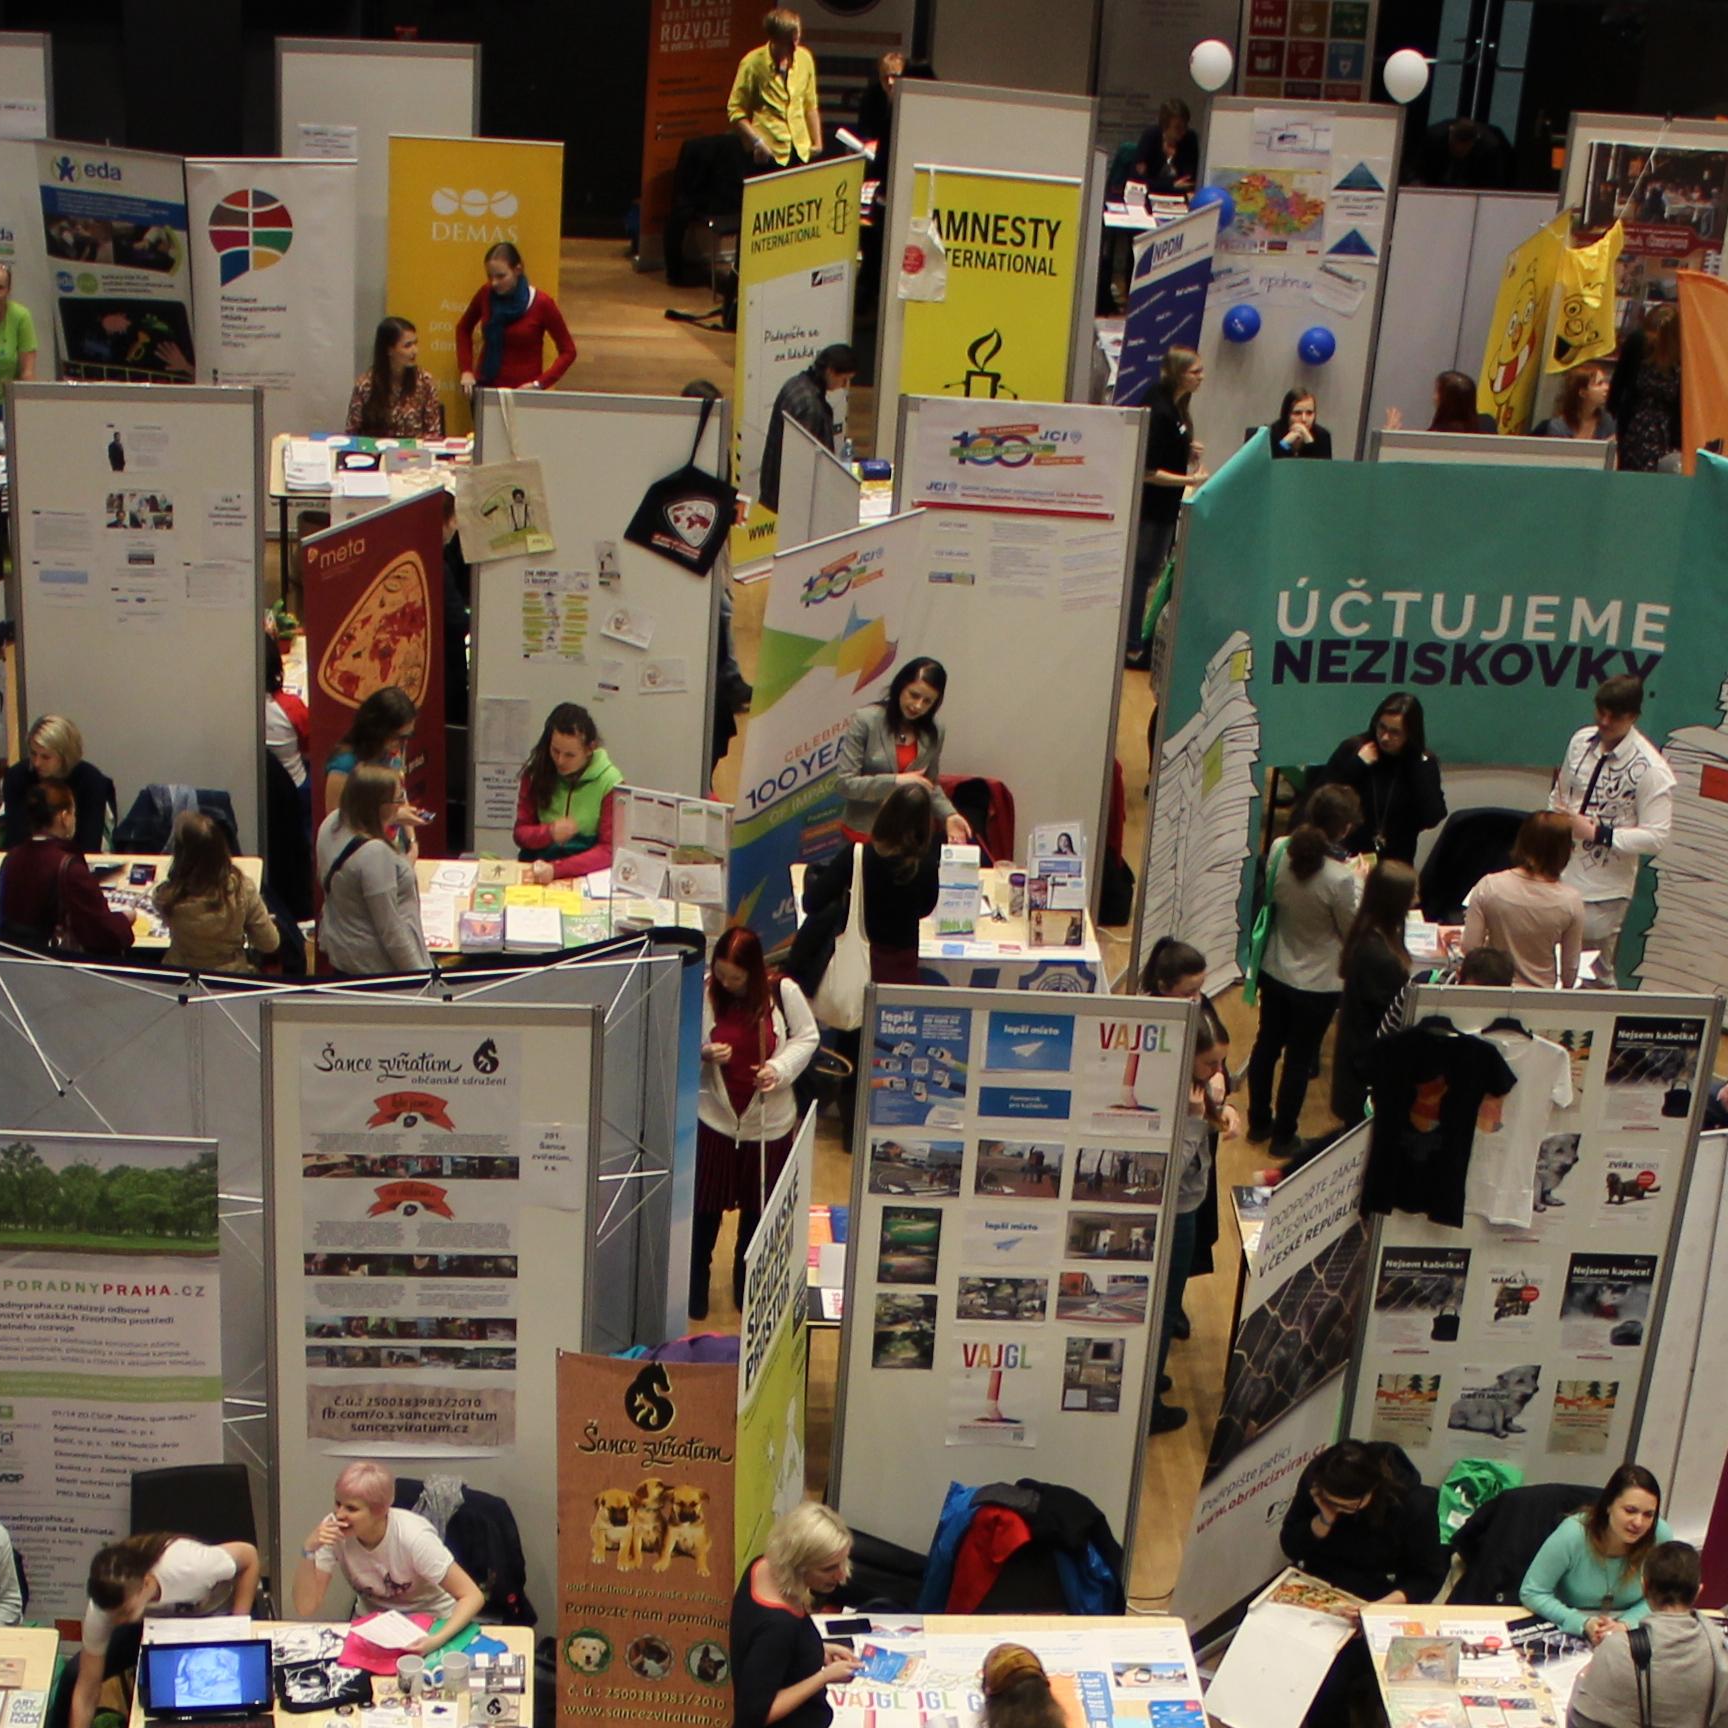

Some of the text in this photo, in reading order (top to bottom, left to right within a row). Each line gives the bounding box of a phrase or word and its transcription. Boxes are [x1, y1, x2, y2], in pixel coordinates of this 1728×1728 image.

[660, 20, 730, 40] ROZVOJE
[84, 160, 122, 181] eda
[753, 199, 822, 236] AMNESTY
[432, 220, 518, 243] DEMAS
[751, 225, 822, 253] INTERNATIONAL
[1153, 236, 1184, 260] NPDM
[1038, 431, 1069, 444] JCI
[319, 538, 364, 567] meta
[1275, 575, 1671, 653] ÚČTUJEME
[1274, 639, 1658, 699] NEZISKOVKY.
[1099, 1022, 1170, 1053] VAJGL
[1617, 1029, 1699, 1042] Nejsem kabelka!
[316, 1042, 463, 1082] Šance zvířatům
[1385, 1258, 1465, 1272] Nejsem kabelka!
[1572, 1264, 1651, 1279] Nejsem kapuce!
[962, 1342, 1032, 1371] VAJGL
[350, 1421, 468, 1435] sancezviratum.cz
[579, 1421, 733, 1467] Šance zvířatům
[563, 1704, 729, 1728] www.sancezviratum.cz
